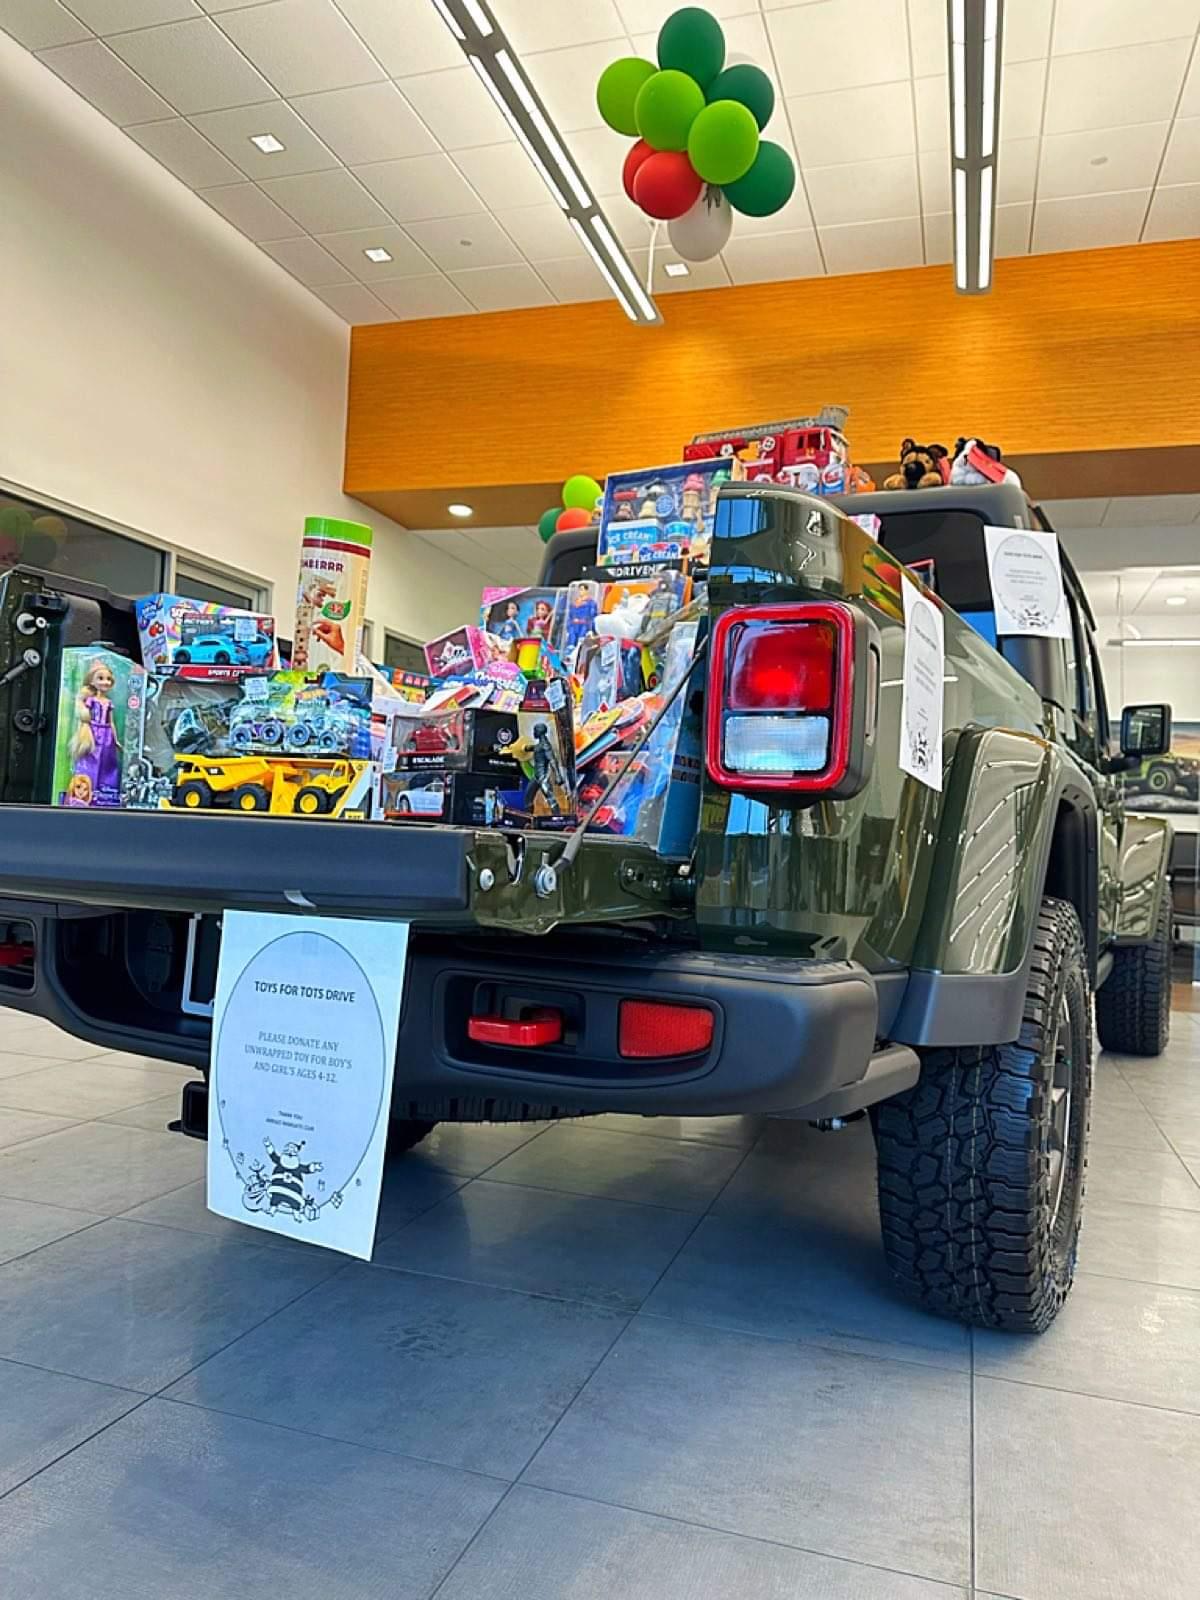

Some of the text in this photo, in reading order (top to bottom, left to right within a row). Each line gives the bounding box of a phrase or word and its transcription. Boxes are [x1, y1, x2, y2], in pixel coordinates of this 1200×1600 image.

[616, 563, 656, 577] DRIVEN
[254, 980, 356, 1002] TOYS FOR TOTS DRIVE
[258, 1031, 340, 1053] PLEASE DONATE ANY
[244, 1044, 353, 1070] UNWRAPPED TOY FOR BOY'S
[254, 1061, 270, 1072] AND
[271, 1063, 296, 1076] GIRL'S
[296, 1068, 317, 1080] AGES
